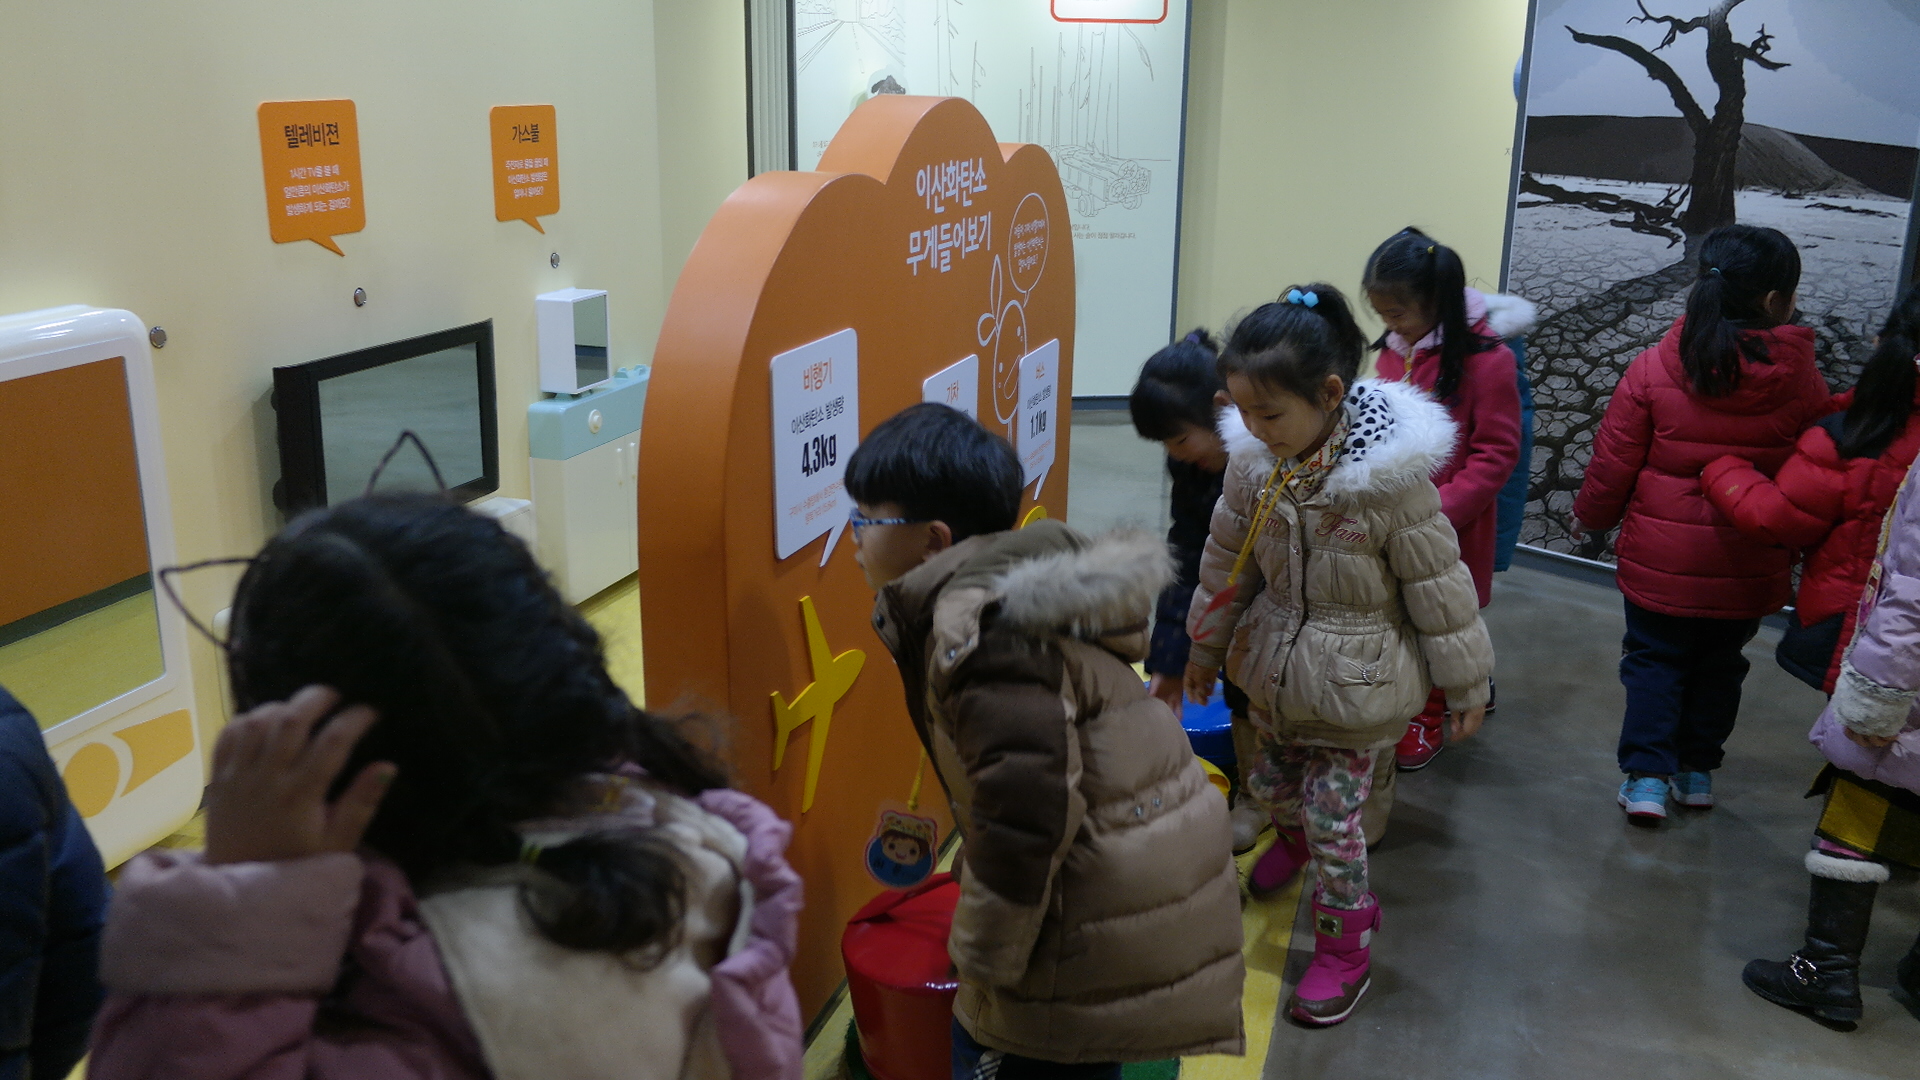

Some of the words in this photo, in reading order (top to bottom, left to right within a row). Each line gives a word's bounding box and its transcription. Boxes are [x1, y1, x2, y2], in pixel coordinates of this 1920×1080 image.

[285, 122, 340, 149] 텔레비젼
[512, 123, 540, 143] 가스불
[290, 167, 307, 179] 1시간
[307, 165, 323, 178] TV를
[916, 157, 988, 214] 이산화탄소
[312, 180, 350, 195] 이산화탄소가
[906, 211, 992, 276] 무게들어보기
[803, 357, 833, 392] 비행기
[946, 379, 959, 404] 기차
[791, 405, 824, 435] 이산화탄소
[825, 395, 845, 420] 발생량
[1030, 409, 1047, 439] 1.1kg
[802, 433, 837, 478] 4.3kg
[1315, 512, 1369, 543] Fam
